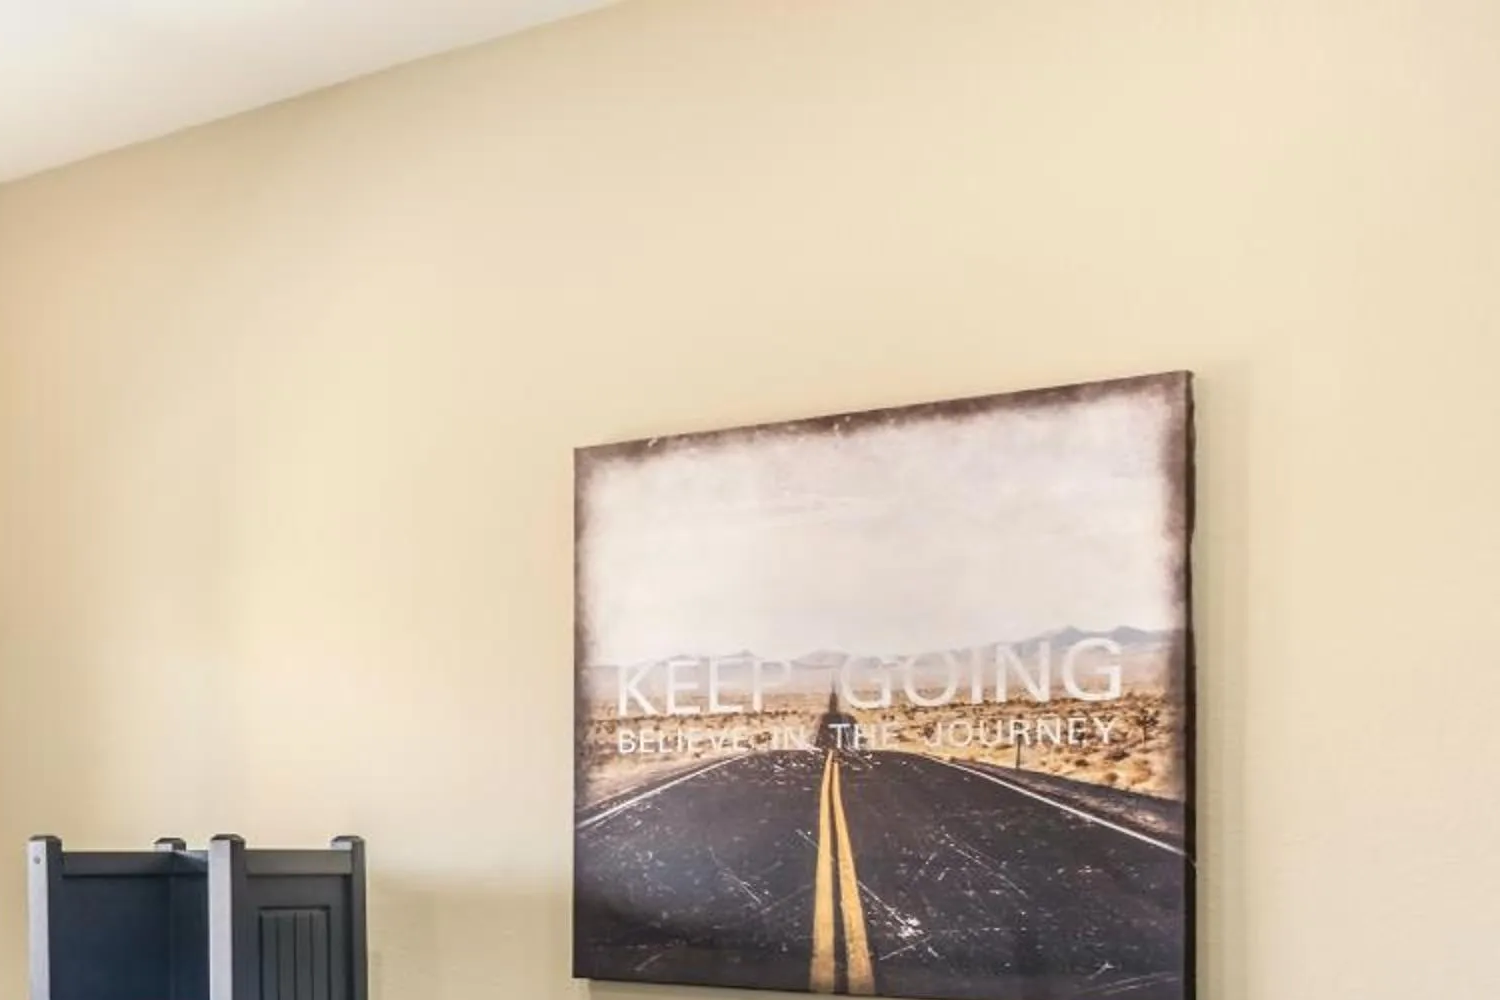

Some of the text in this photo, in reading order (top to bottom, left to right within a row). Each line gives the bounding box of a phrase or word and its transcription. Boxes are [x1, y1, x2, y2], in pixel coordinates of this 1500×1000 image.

[617, 637, 1123, 717] KEEP GOING
[618, 713, 1118, 754] BELIEVE IN THE JOURNEY
